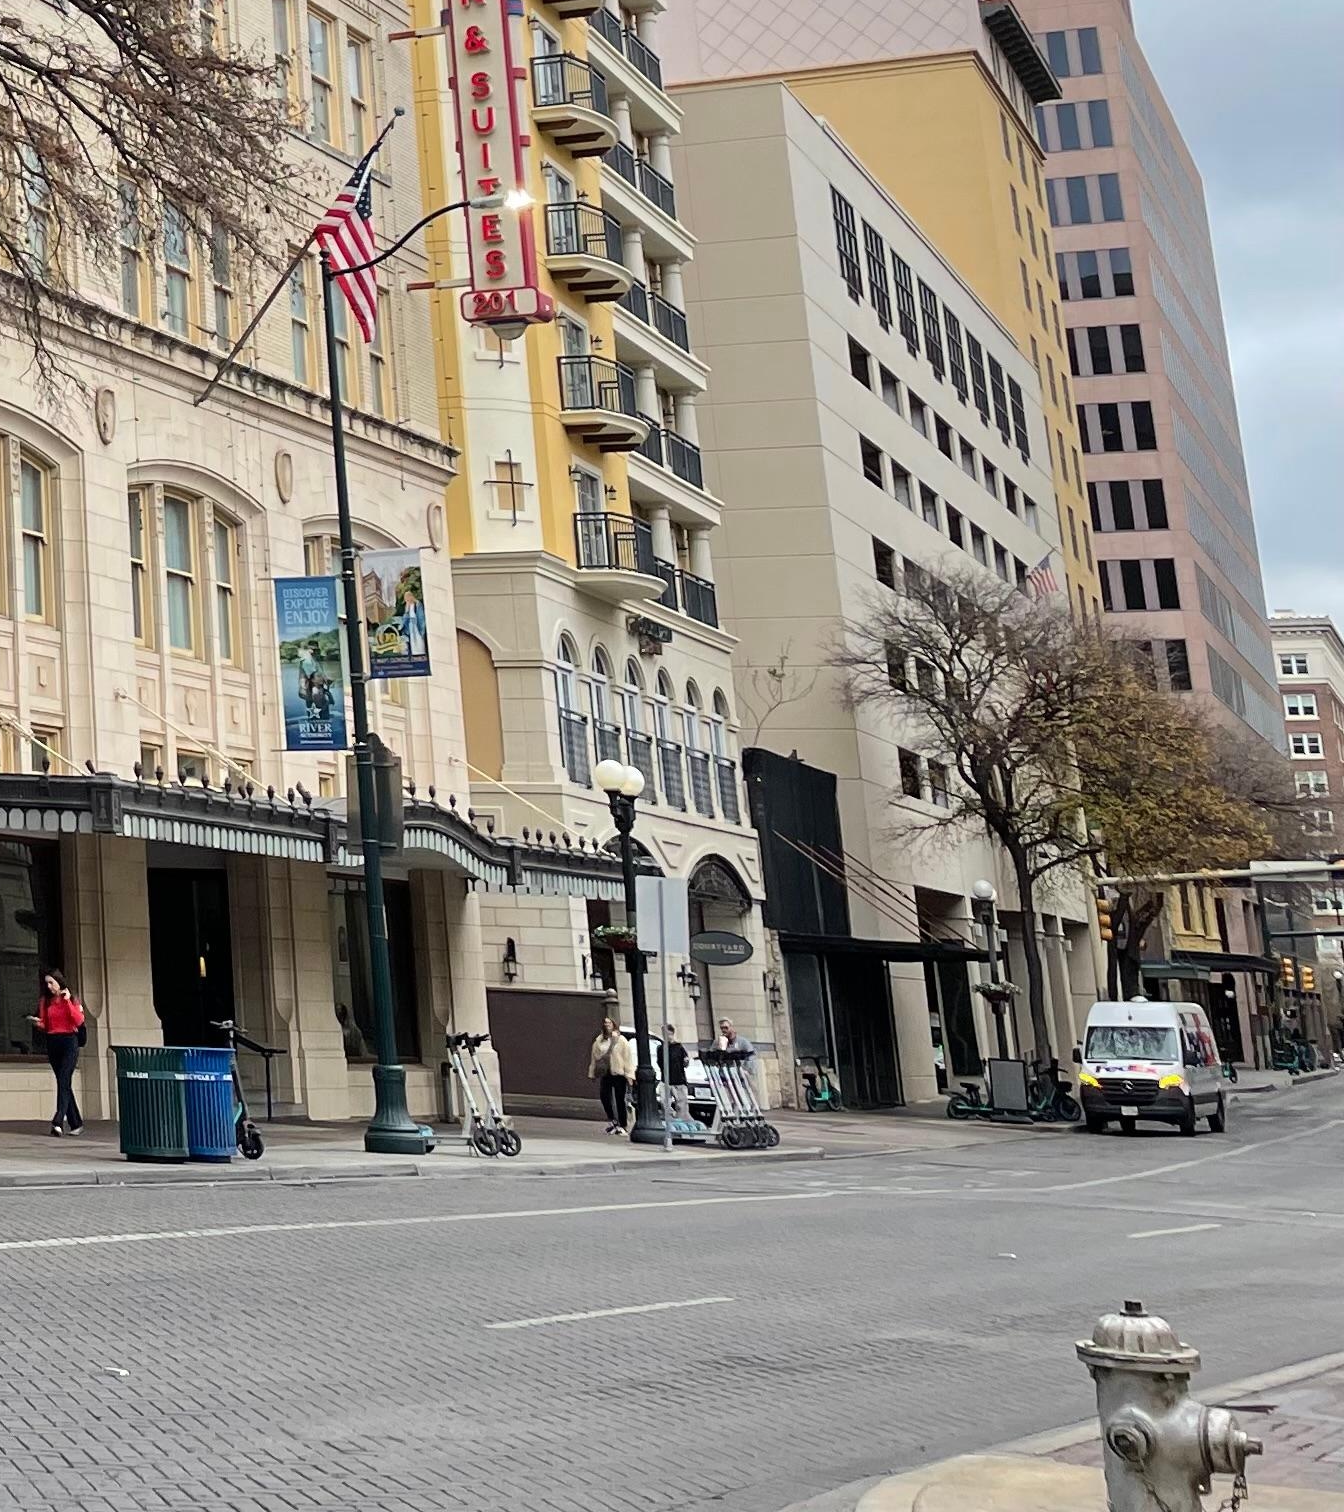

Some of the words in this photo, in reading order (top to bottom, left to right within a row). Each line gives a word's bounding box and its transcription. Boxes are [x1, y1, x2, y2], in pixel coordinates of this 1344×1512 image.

[464, 25, 490, 54] &
[471, 72, 508, 280] SUITES
[472, 290, 518, 316] 201
[283, 587, 329, 598] DISCOVER
[284, 598, 329, 609] EXPLORE
[285, 609, 330, 625] ENJOY
[299, 722, 333, 733] RIVER
